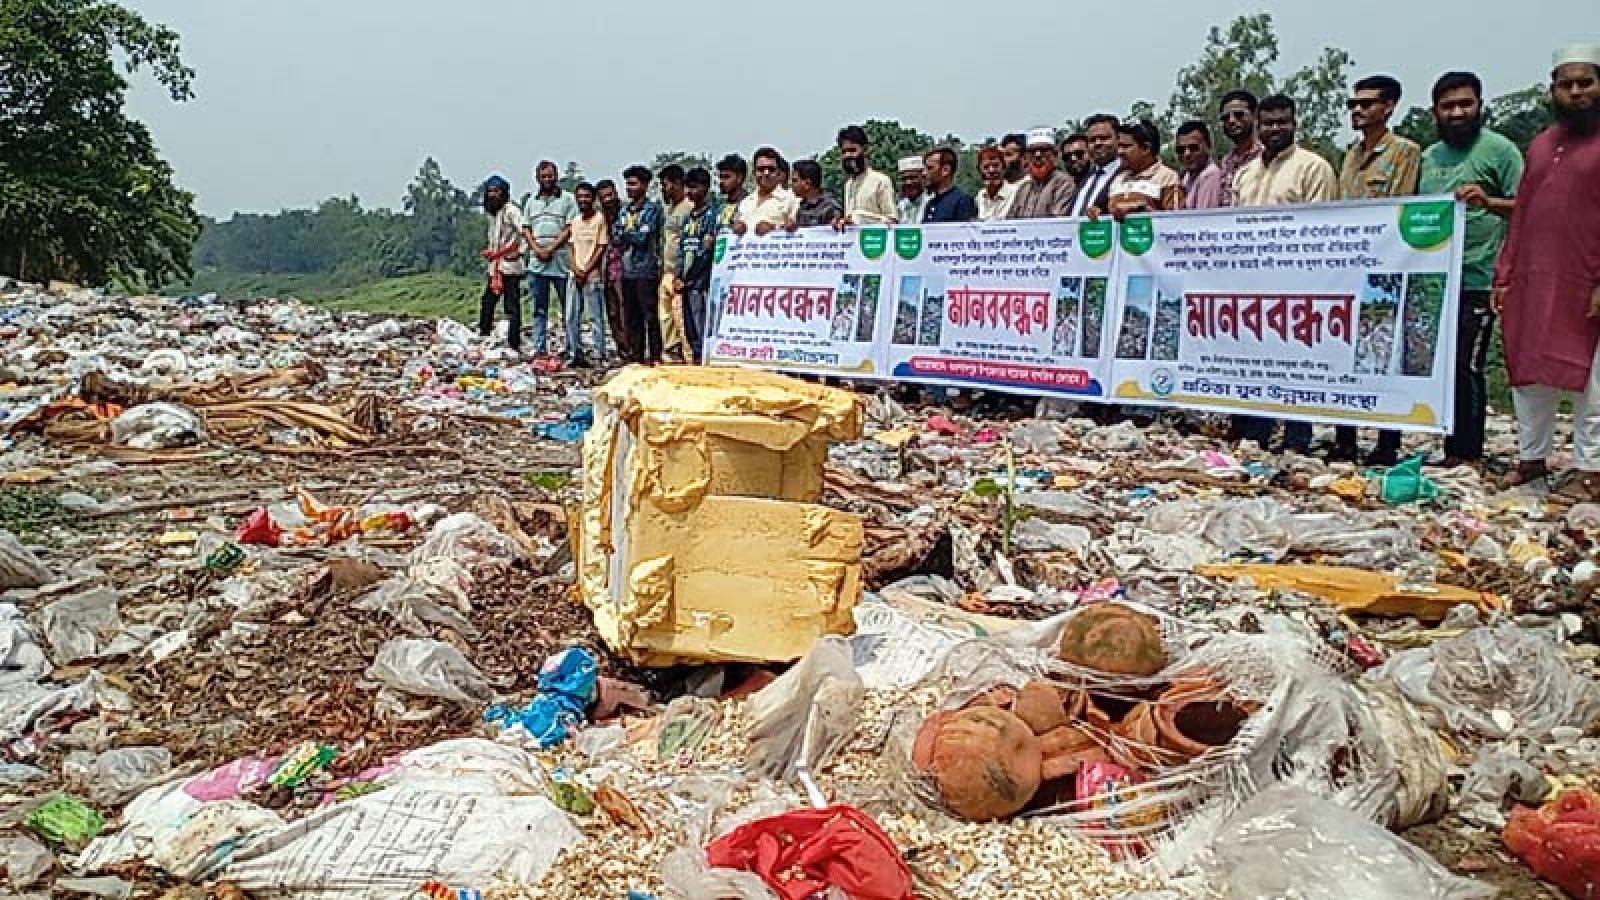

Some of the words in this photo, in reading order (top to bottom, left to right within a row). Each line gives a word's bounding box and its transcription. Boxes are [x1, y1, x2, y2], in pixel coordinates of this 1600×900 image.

[727, 285, 835, 322] মানববন্ধন
[946, 288, 1051, 336] মানববন্ধন
[1185, 293, 1356, 348] মানববন্ধন
